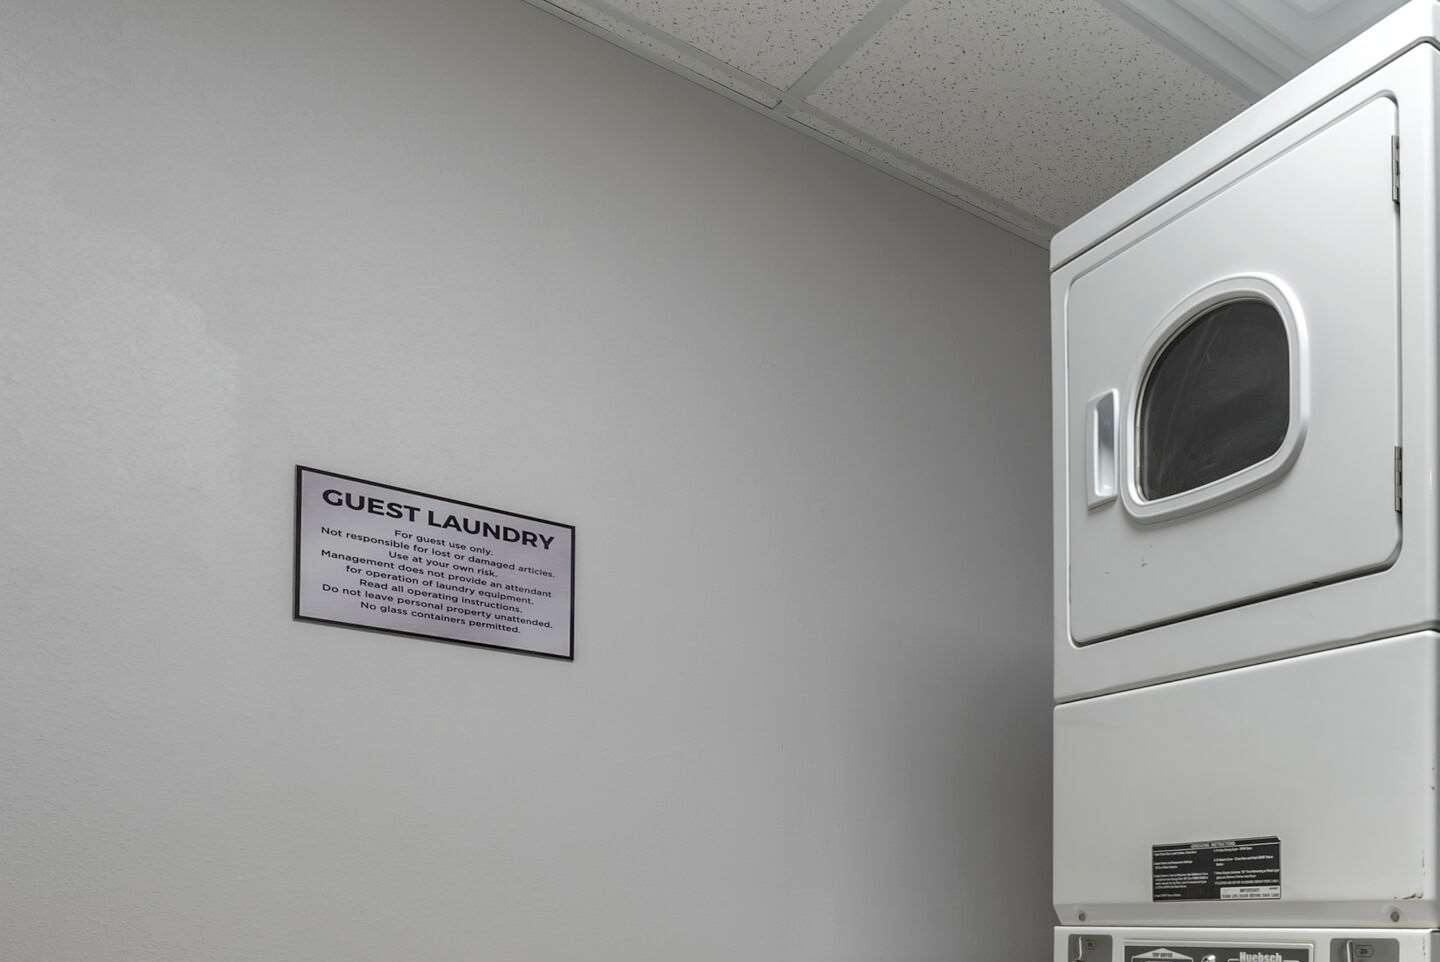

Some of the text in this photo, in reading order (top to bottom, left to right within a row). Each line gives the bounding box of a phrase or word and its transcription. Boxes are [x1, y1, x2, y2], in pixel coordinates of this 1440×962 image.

[322, 489, 555, 550] GUEST LAUNDRY
[321, 527, 555, 578] Not responsible for lost or damaged articles.
[394, 529, 494, 556] For guest use only.
[321, 549, 552, 598] Management does not provide an attendant
[389, 551, 409, 561] Use
[426, 559, 450, 569] your
[453, 564, 474, 573] own
[477, 567, 498, 577] risk.
[345, 565, 534, 605] for operation of laundry equipment.
[360, 579, 522, 613] Read all operating instructions.
[322, 584, 553, 628] Do not leave personal property unattended.
[361, 601, 521, 633] No glass containers permitted.
